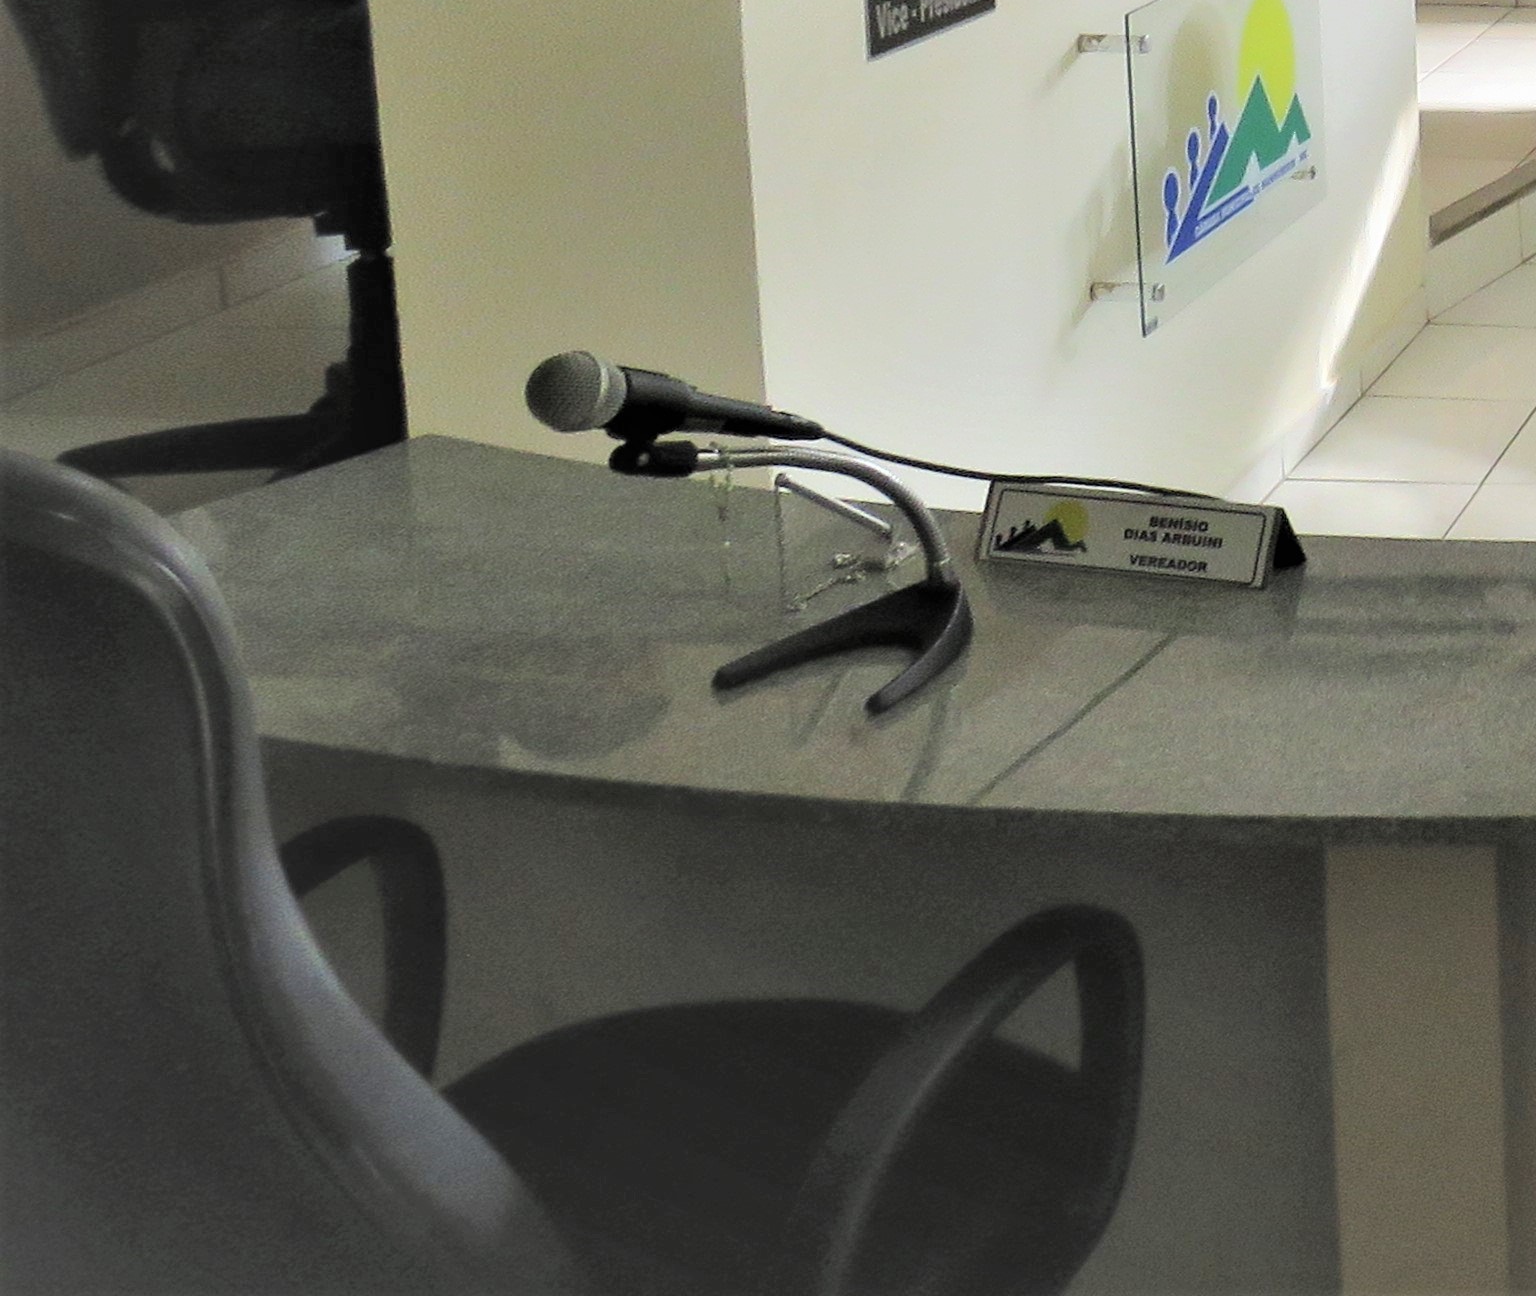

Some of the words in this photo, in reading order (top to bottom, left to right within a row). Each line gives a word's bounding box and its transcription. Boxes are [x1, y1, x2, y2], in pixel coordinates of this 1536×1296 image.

[875, 0, 909, 39] Vice
[1123, 527, 1158, 543] DIAS
[1129, 554, 1209, 573] VEREADOR
